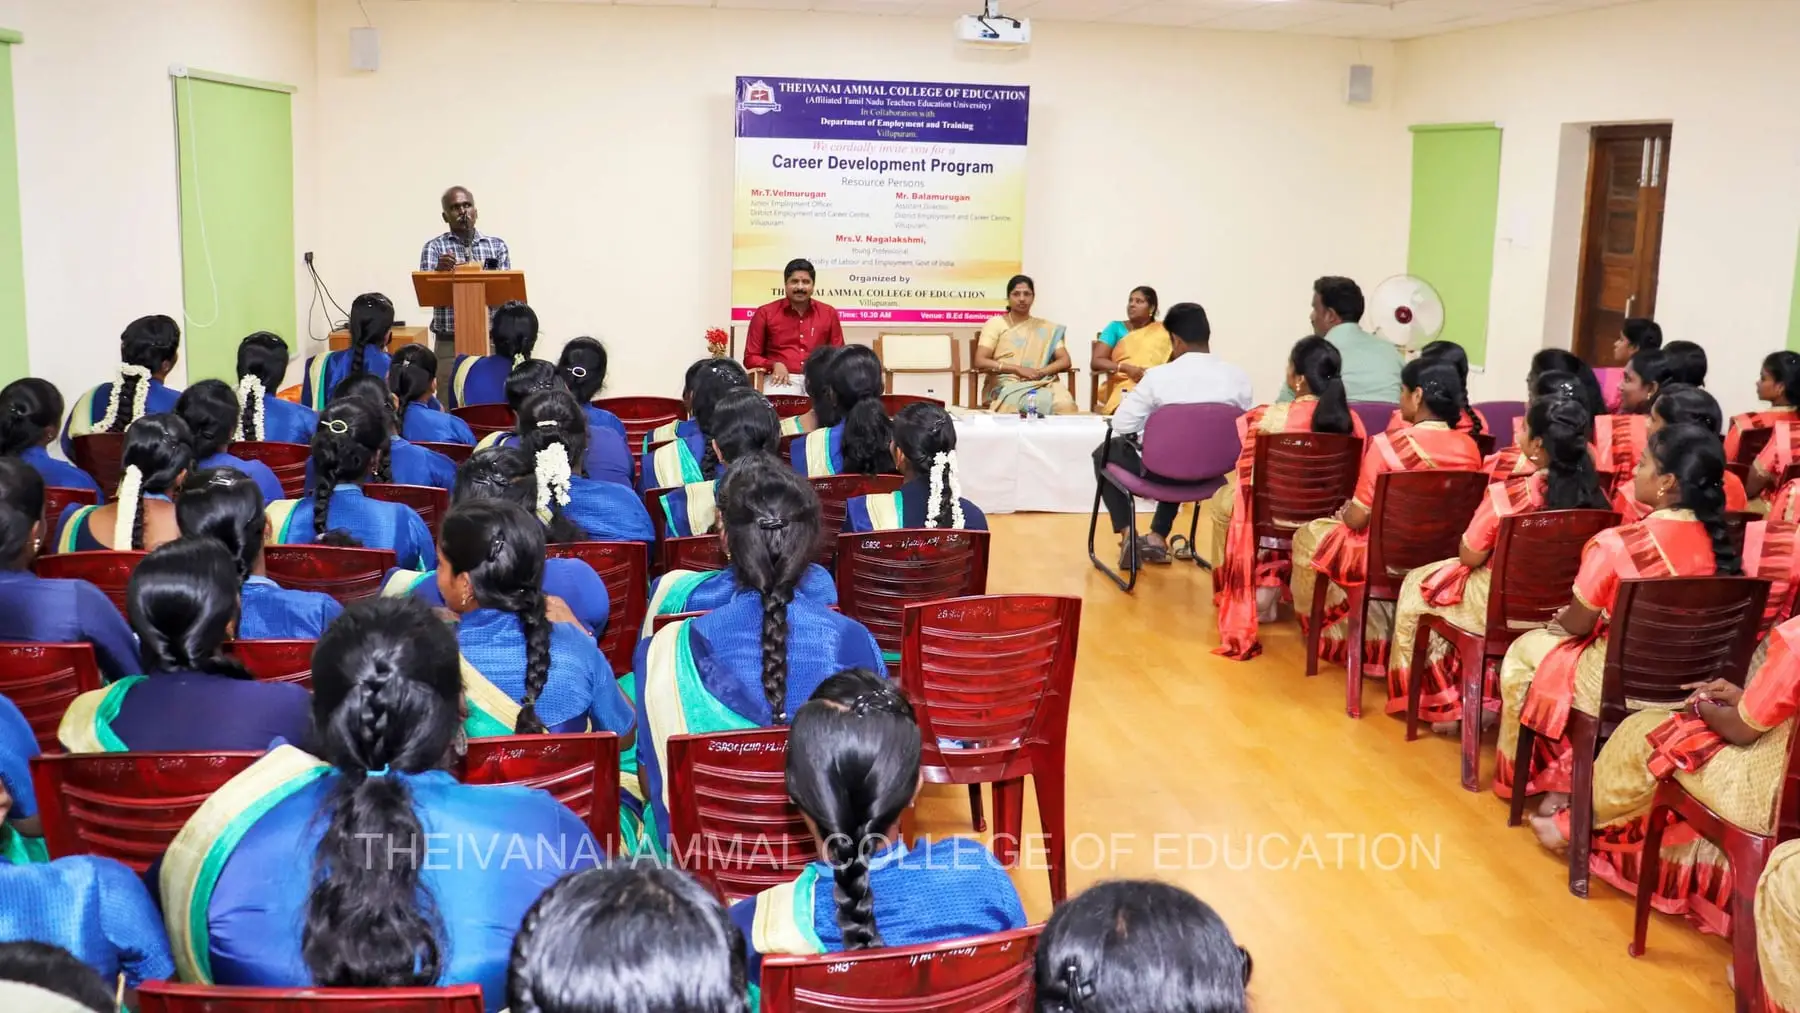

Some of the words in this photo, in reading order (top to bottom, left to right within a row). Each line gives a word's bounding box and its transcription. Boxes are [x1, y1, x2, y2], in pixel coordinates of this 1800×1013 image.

[779, 83, 841, 94] THEIVANAI
[844, 85, 887, 95] AMMAL
[889, 86, 942, 97] COLLEGE
[945, 88, 960, 98] OF
[963, 89, 1026, 100] EDUCATION
[805, 96, 841, 105] (Affiliated
[844, 97, 863, 105] Tamil
[886, 98, 916, 107] Teachers
[917, 99, 952, 108] Education
[953, 101, 991, 111] University)
[860, 108, 868, 116] In
[870, 108, 918, 117] Collaboration
[919, 110, 935, 118] with
[821, 117, 865, 127] Department
[867, 118, 876, 126] of
[877, 119, 924, 129] Employment
[942, 121, 974, 131] Training
[813, 141, 827, 151] We
[830, 142, 875, 154] cordially
[879, 143, 909, 153] invite
[910, 146, 928, 156] you
[930, 144, 945, 156] for
[948, 147, 956, 155] a
[772, 154, 823, 169] Career
[828, 155, 925, 174] Development
[931, 158, 994, 176] Program
[842, 177, 885, 187] Resource
[888, 178, 925, 188] Persons
[751, 189, 827, 199] Mr.T.Velmurugan
[896, 192, 909, 200] Mr.
[912, 193, 970, 202] Balamurugan
[771, 200, 809, 209] Employment
[750, 209, 772, 217] District
[774, 210, 813, 219] Employment
[828, 210, 848, 218] Career
[836, 235, 862, 243] Mrs.V.
[866, 236, 926, 245] Nagalakshmi,
[830, 257, 837, 265] of
[849, 275, 896, 284] Organized
[900, 275, 910, 284] by
[826, 288, 865, 297] AMMAL
[867, 289, 912, 298] COLLEGE
[915, 289, 926, 298] OF
[930, 290, 985, 298] EDUCATION
